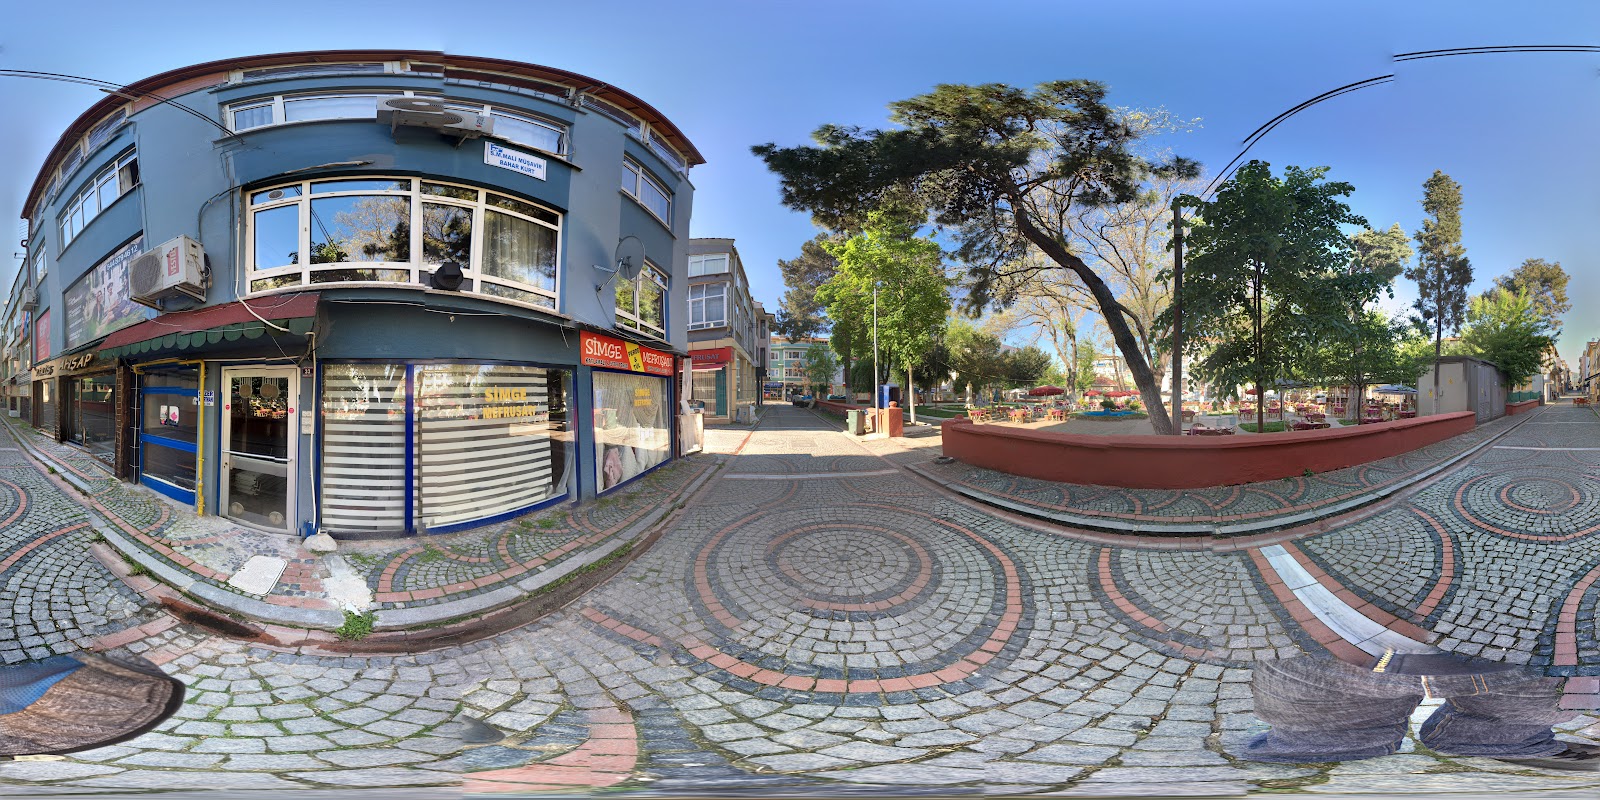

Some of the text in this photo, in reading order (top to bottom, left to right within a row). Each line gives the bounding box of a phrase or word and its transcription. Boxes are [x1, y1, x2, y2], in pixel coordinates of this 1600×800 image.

[499, 160, 535, 175] BAHAR KURT
[585, 337, 622, 360] SİMGE
[484, 384, 527, 403] SİMGE
